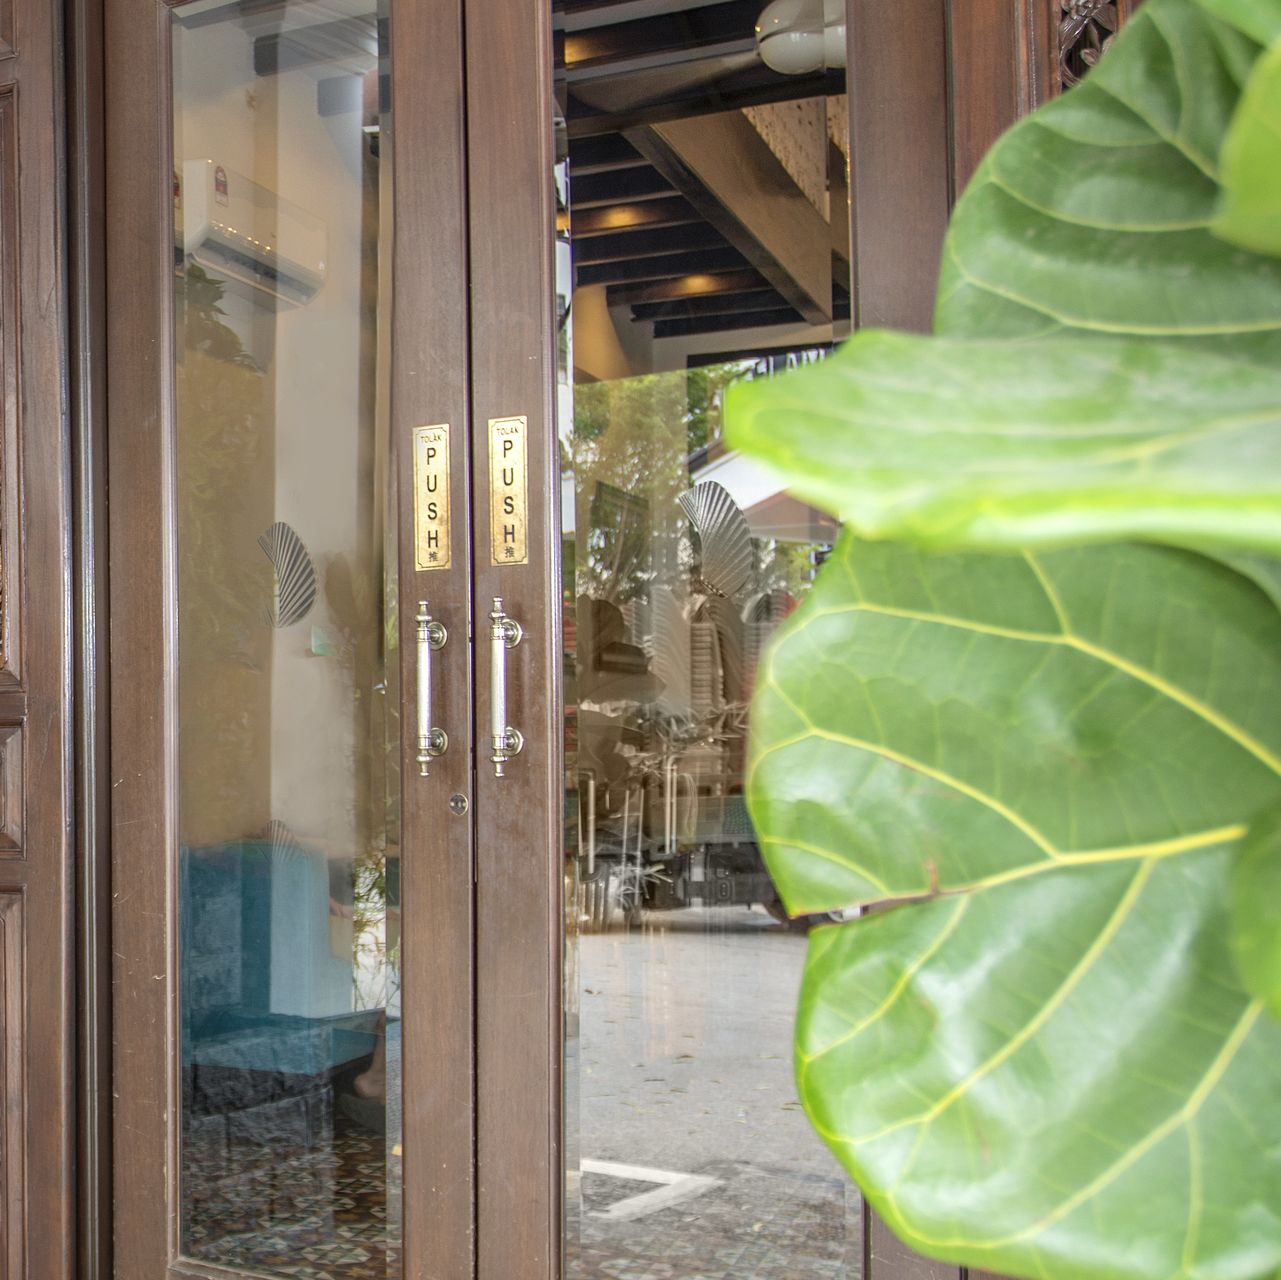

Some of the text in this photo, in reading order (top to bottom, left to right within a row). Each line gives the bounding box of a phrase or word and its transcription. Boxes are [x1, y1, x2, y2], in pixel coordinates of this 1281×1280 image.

[496, 426, 519, 436] TOLAK
[420, 432, 442, 443] TOLAK
[503, 440, 516, 543] PUSH
[426, 447, 439, 549] PUSH
[428, 551, 439, 562] 推
[504, 546, 516, 558] 推
